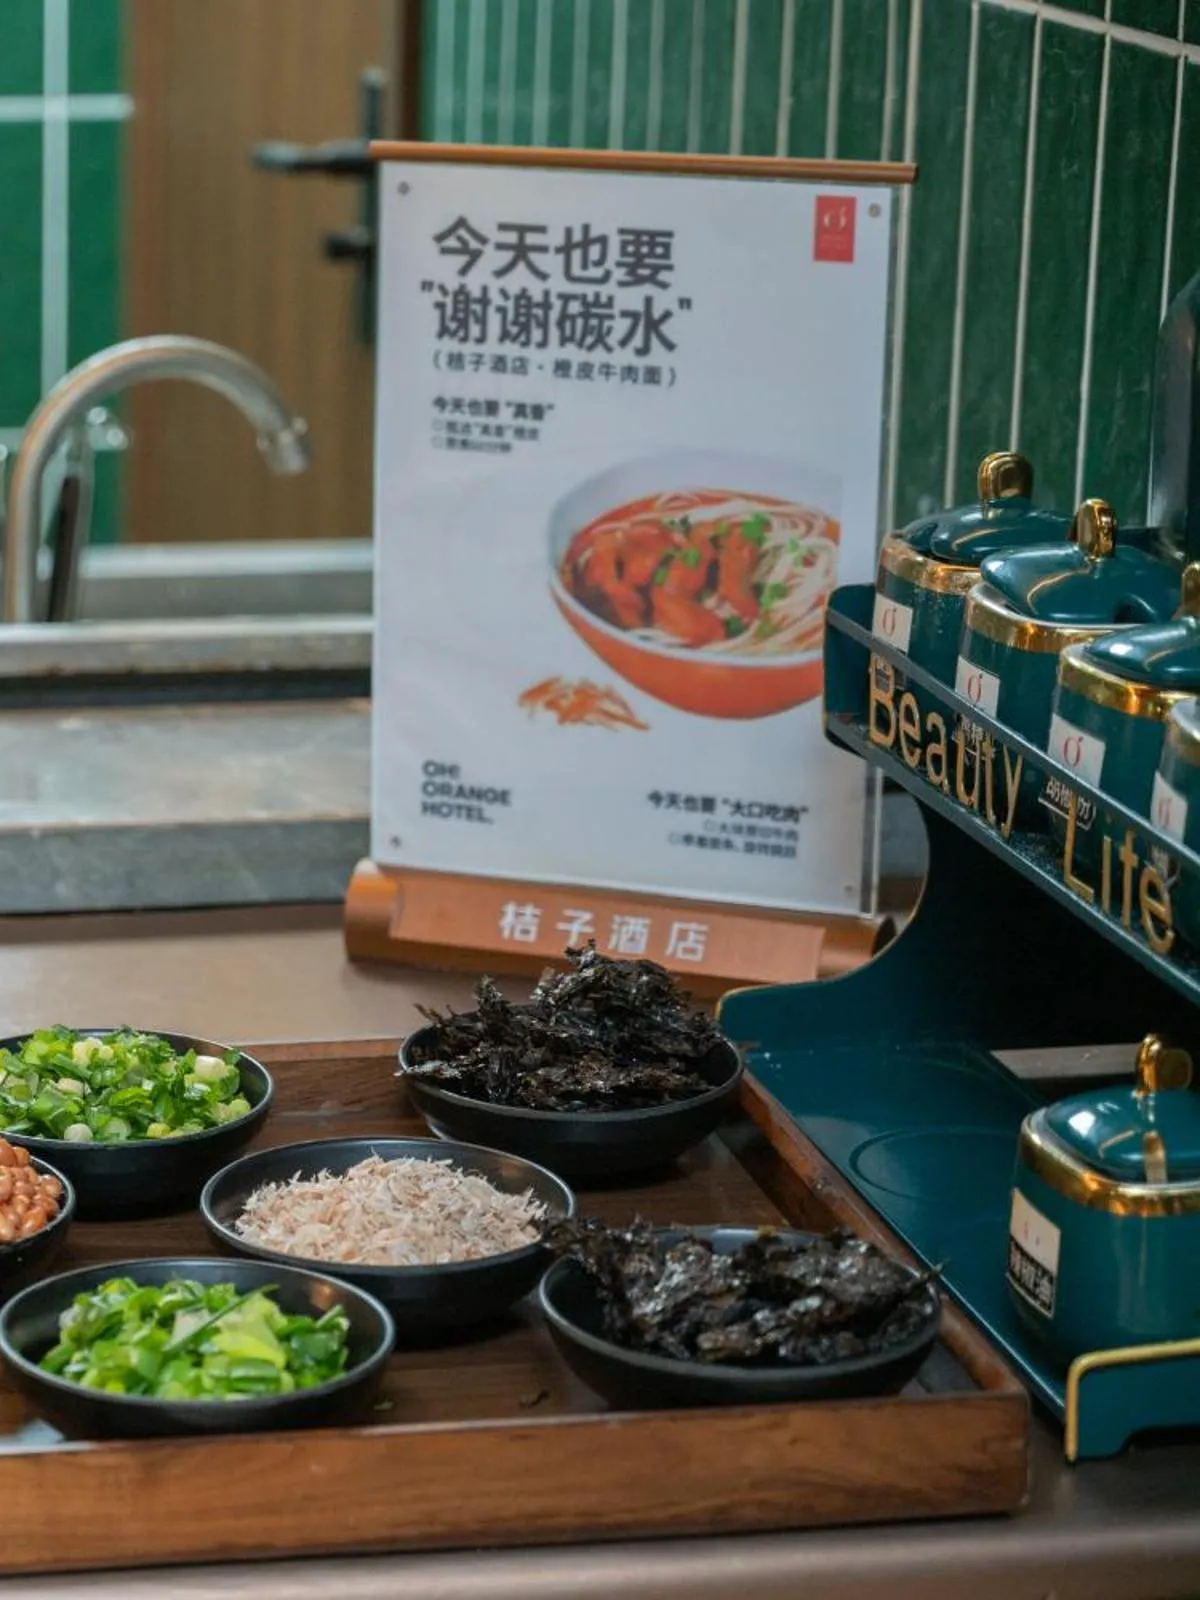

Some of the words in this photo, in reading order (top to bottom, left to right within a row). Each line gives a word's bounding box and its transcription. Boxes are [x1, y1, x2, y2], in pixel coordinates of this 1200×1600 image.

[433, 216, 675, 290] 今天也要
[869, 652, 1023, 838] Beauty
[422, 781, 512, 806] ORANGE
[499, 901, 708, 962] 桔子酒店
